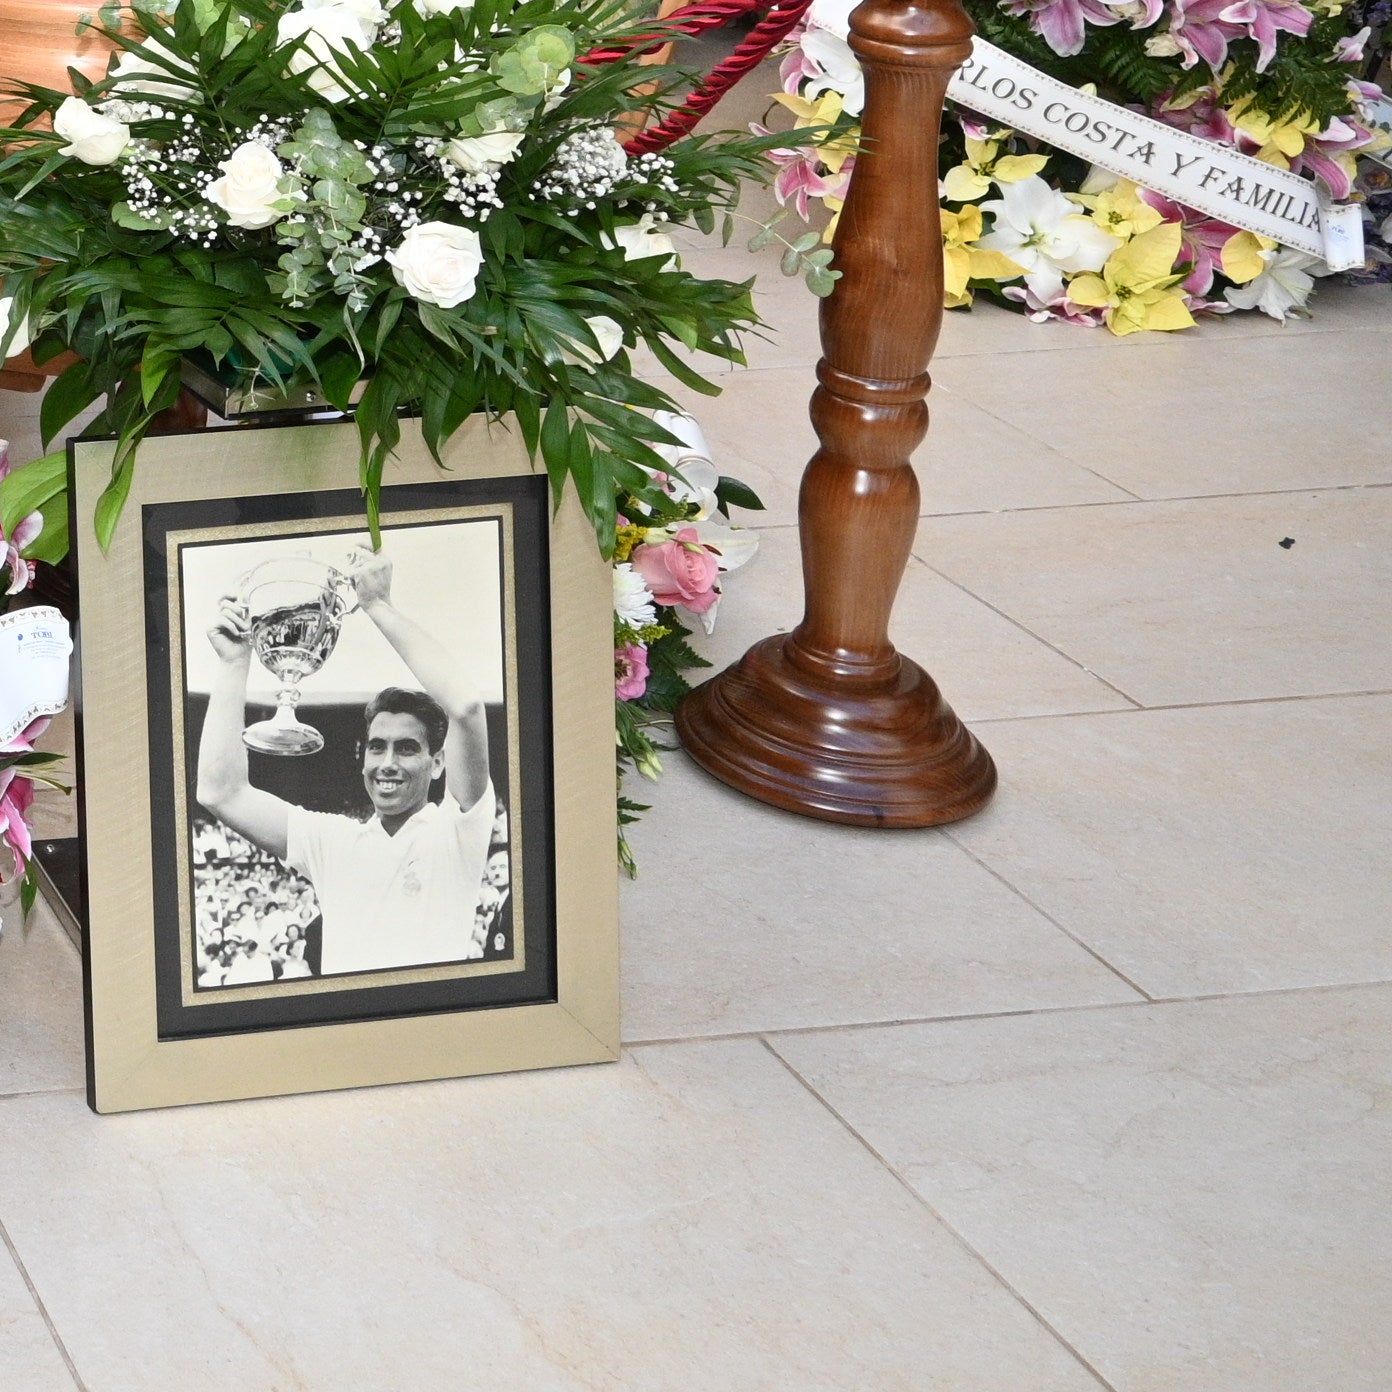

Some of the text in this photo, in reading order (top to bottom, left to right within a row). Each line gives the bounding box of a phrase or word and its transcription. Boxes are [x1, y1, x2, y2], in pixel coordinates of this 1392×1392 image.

[957, 57, 1321, 234] RLOS COSTA Y FAMILIA
